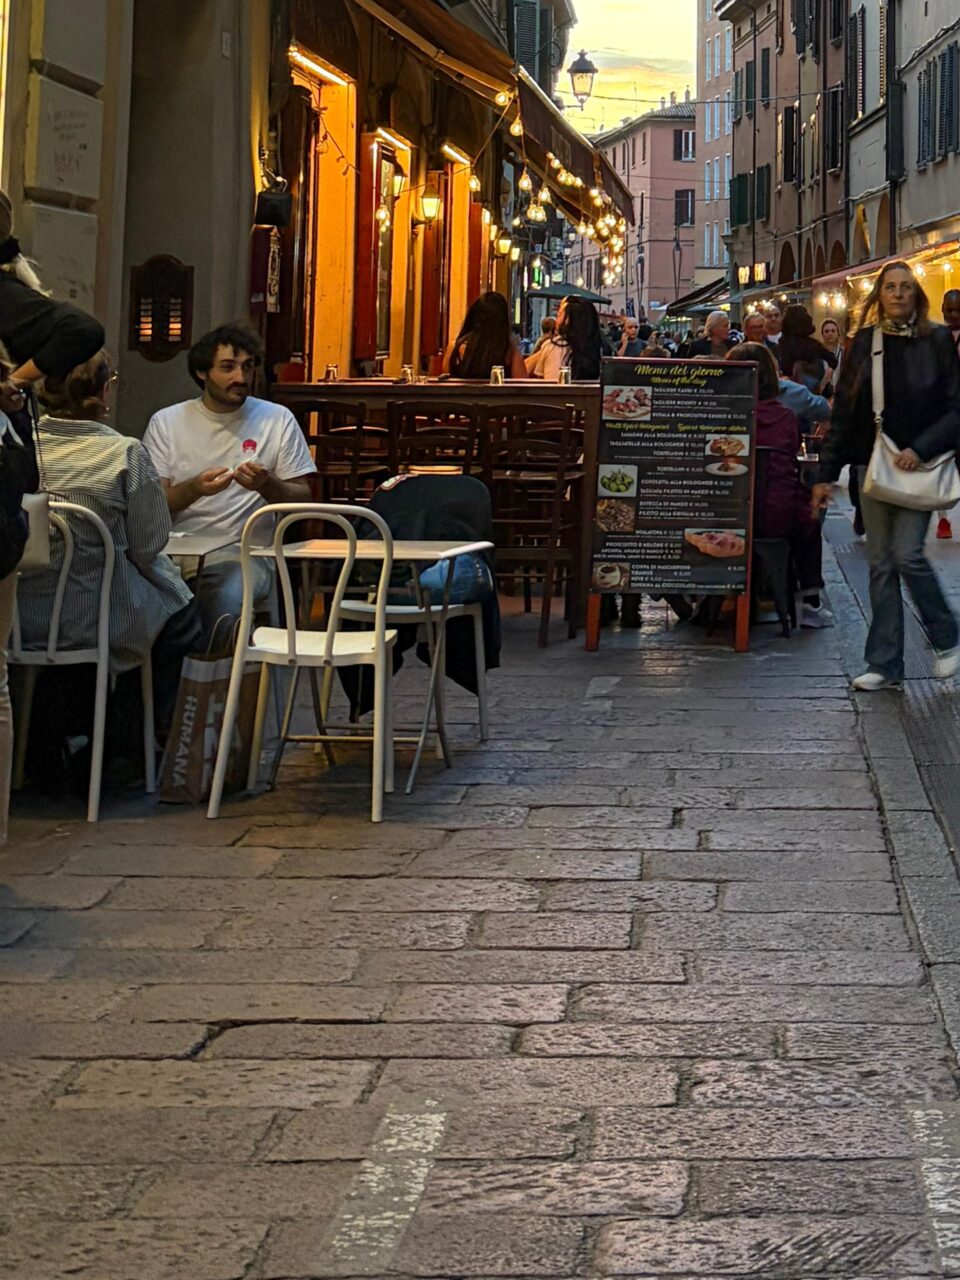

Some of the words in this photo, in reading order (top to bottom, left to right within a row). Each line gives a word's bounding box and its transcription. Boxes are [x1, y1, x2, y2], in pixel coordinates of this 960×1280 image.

[634, 365, 667, 376] Menu
[669, 365, 688, 376] del
[173, 695, 197, 787] HUMANA
